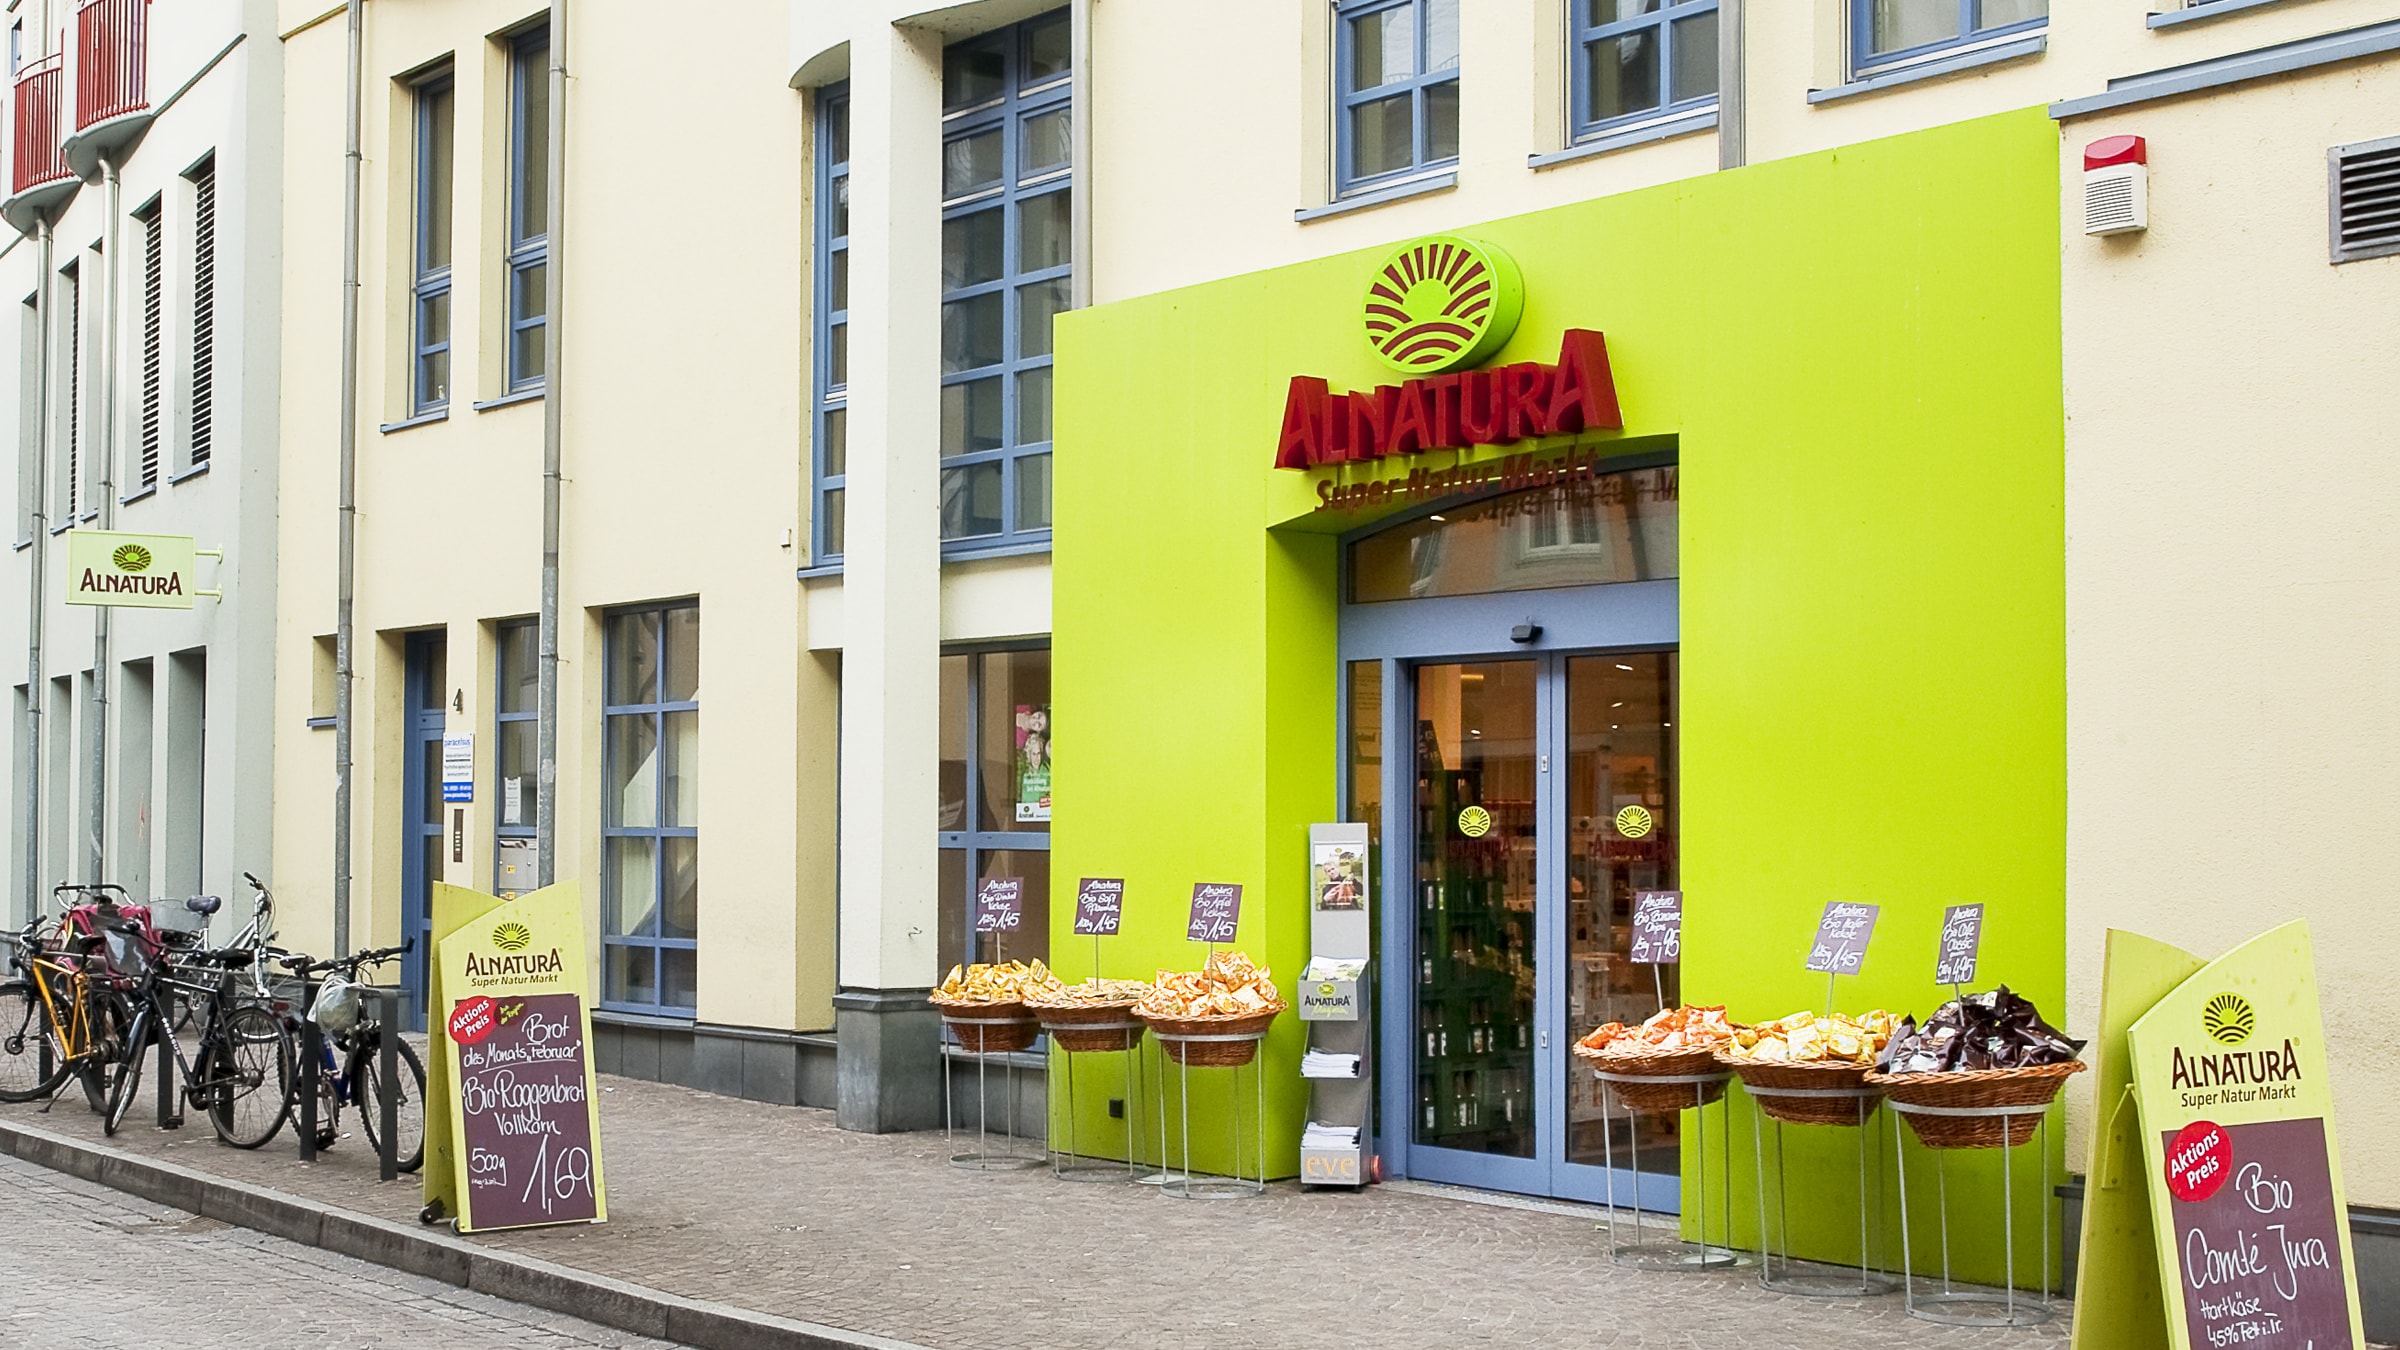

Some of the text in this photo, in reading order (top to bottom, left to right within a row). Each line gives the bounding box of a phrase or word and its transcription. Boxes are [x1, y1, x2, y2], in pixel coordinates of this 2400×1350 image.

[1274, 329, 1623, 470] ALNATURA
[1314, 446, 1599, 514] Super Natur Markt
[80, 567, 182, 596] ALNATURA
[453, 688, 463, 714] 4
[1206, 917, 1237, 940] 1,45
[465, 948, 563, 976] ALNATURA
[471, 974, 559, 988] Super Natur Markt
[1304, 995, 1350, 1006] ALNATURA
[453, 1000, 490, 1033] Aktions
[465, 1014, 490, 1038] Preis
[522, 1013, 570, 1045] Brot
[463, 1047, 485, 1068] des
[485, 1042, 527, 1069] Monats
[2172, 1039, 2301, 1089] ALNATURA
[462, 1069, 585, 1120] Bio Roggenbrot
[2181, 1084, 2296, 1109] Super Natur Markt
[494, 1109, 561, 1136] Vollkorn
[1305, 1156, 1355, 1176] eve
[2171, 1129, 2220, 1179] Aktions
[470, 1134, 593, 1215] 500g 1,69
[2186, 1154, 2220, 1190] Preis
[2235, 1162, 2293, 1214] Bio
[2186, 1224, 2330, 1301] Comté Jura
[2200, 1292, 2262, 1319] Hartkäse
